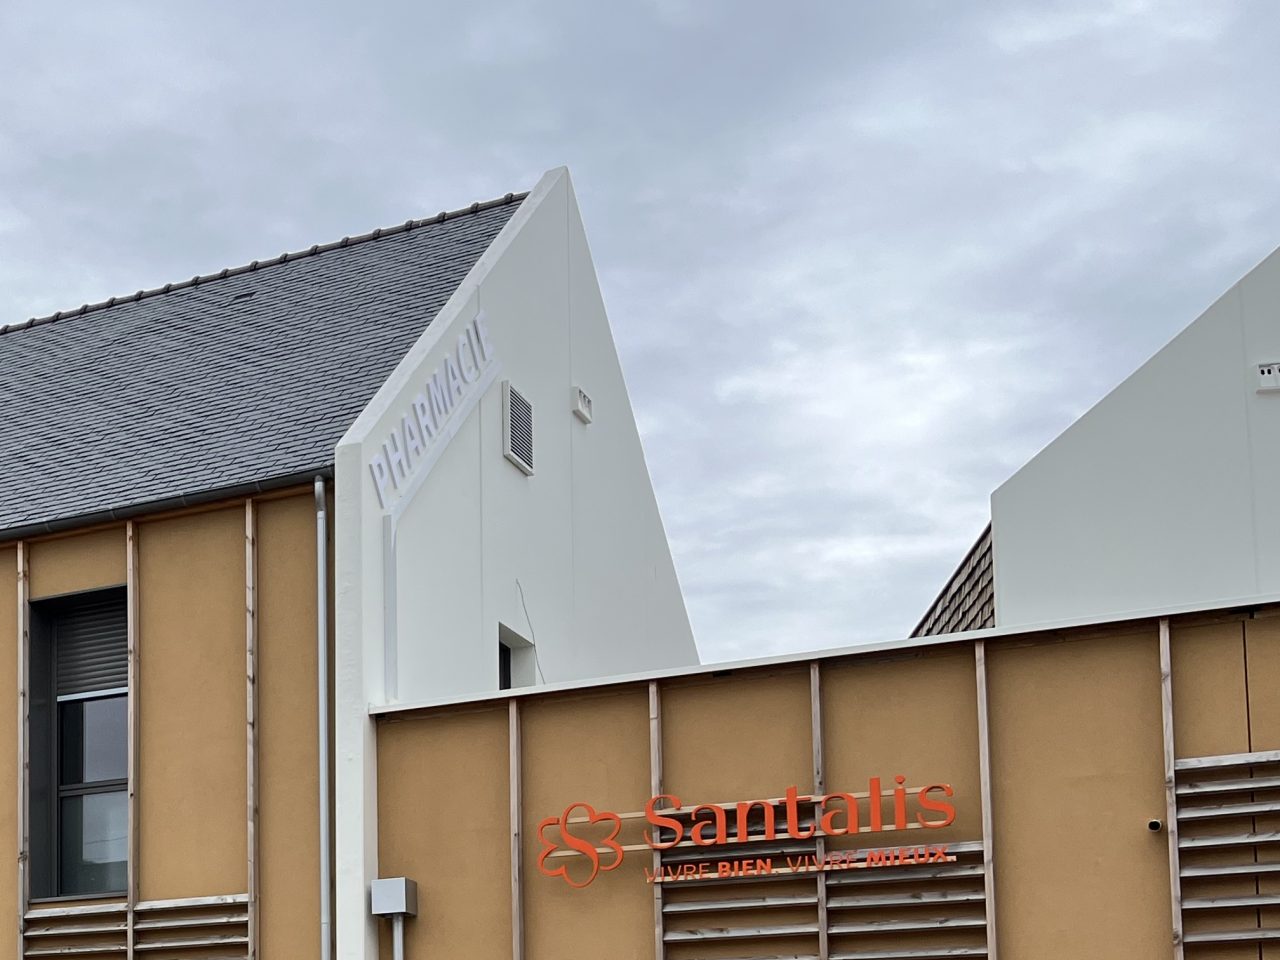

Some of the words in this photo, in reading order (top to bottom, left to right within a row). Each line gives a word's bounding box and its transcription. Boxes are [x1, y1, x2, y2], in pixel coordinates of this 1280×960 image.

[643, 774, 956, 851] Santalis
[643, 862, 712, 883] VIVRE
[786, 850, 859, 874] VIVRE
